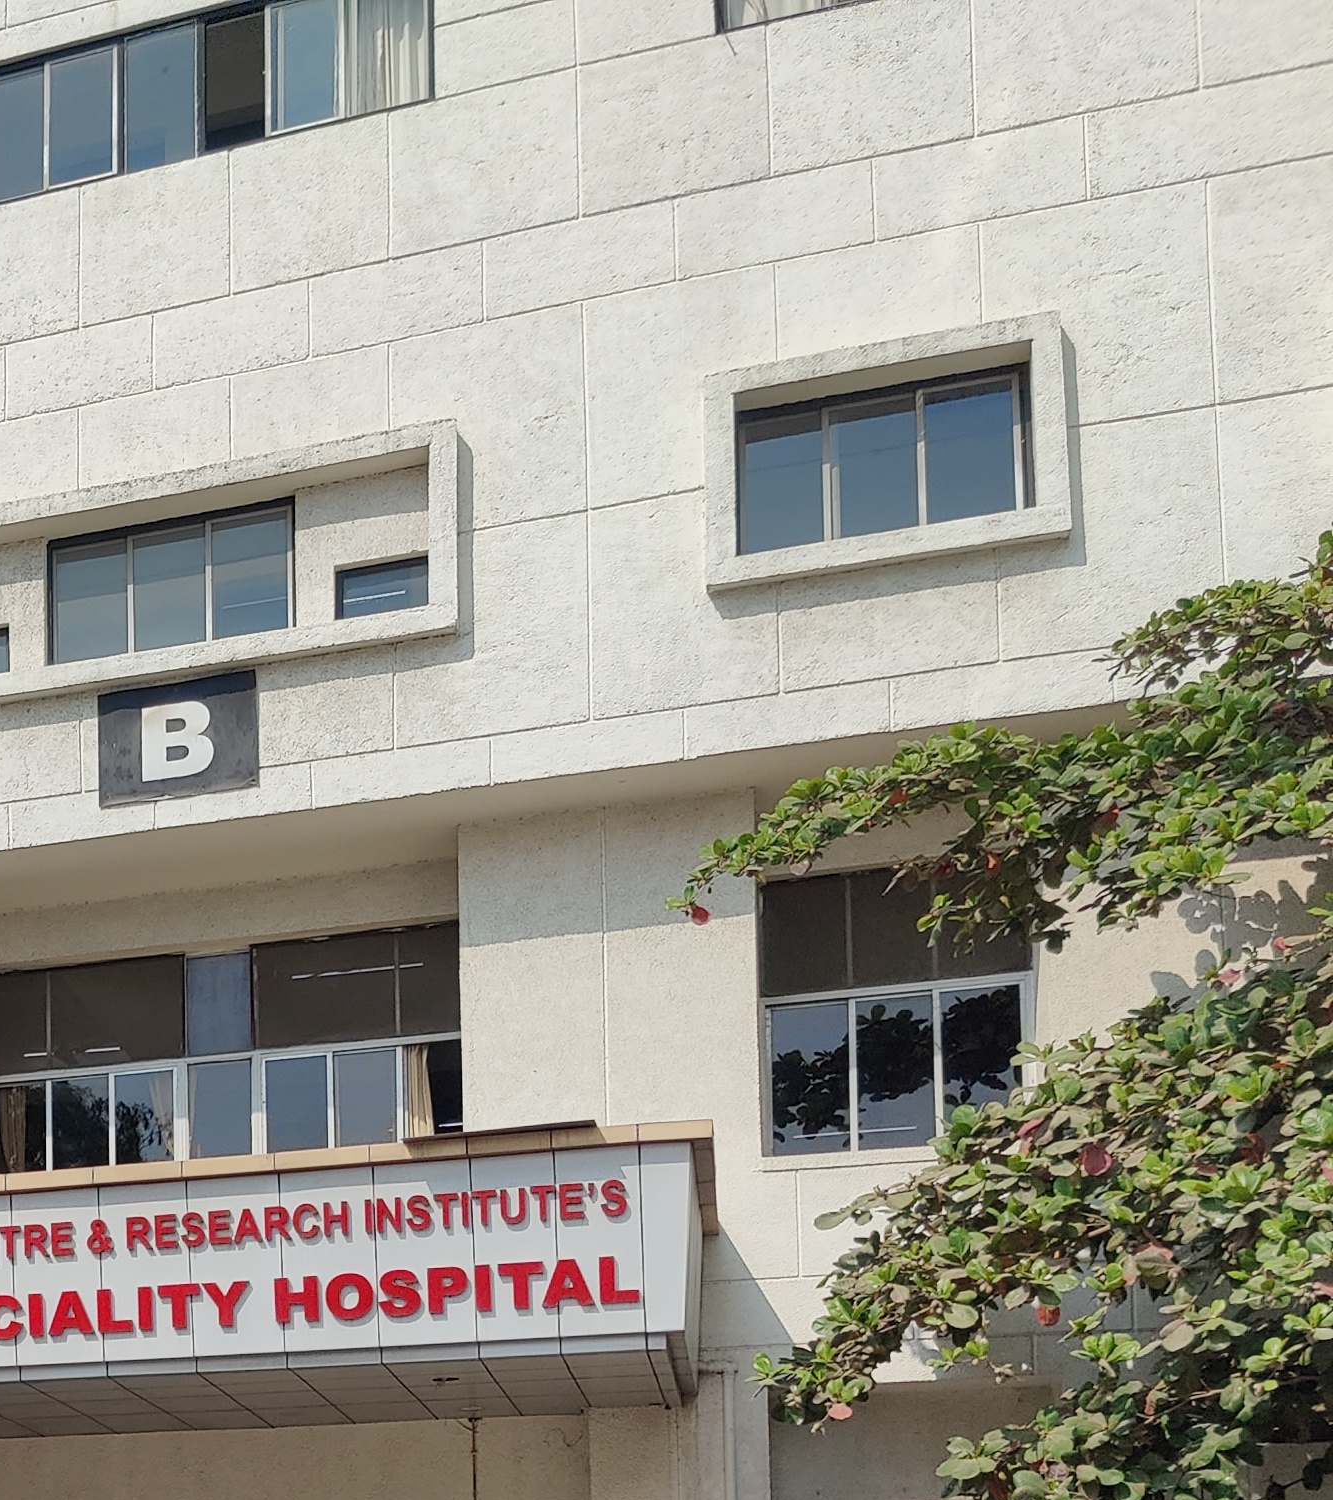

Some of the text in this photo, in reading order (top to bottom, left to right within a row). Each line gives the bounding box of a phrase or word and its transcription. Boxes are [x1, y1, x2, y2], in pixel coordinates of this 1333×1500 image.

[142, 700, 215, 782] B
[87, 1218, 113, 1254] &
[126, 1200, 349, 1250] RESEARCH
[364, 1178, 628, 1234] INSTITUTE'S
[273, 1256, 640, 1324] HOSPITAL
